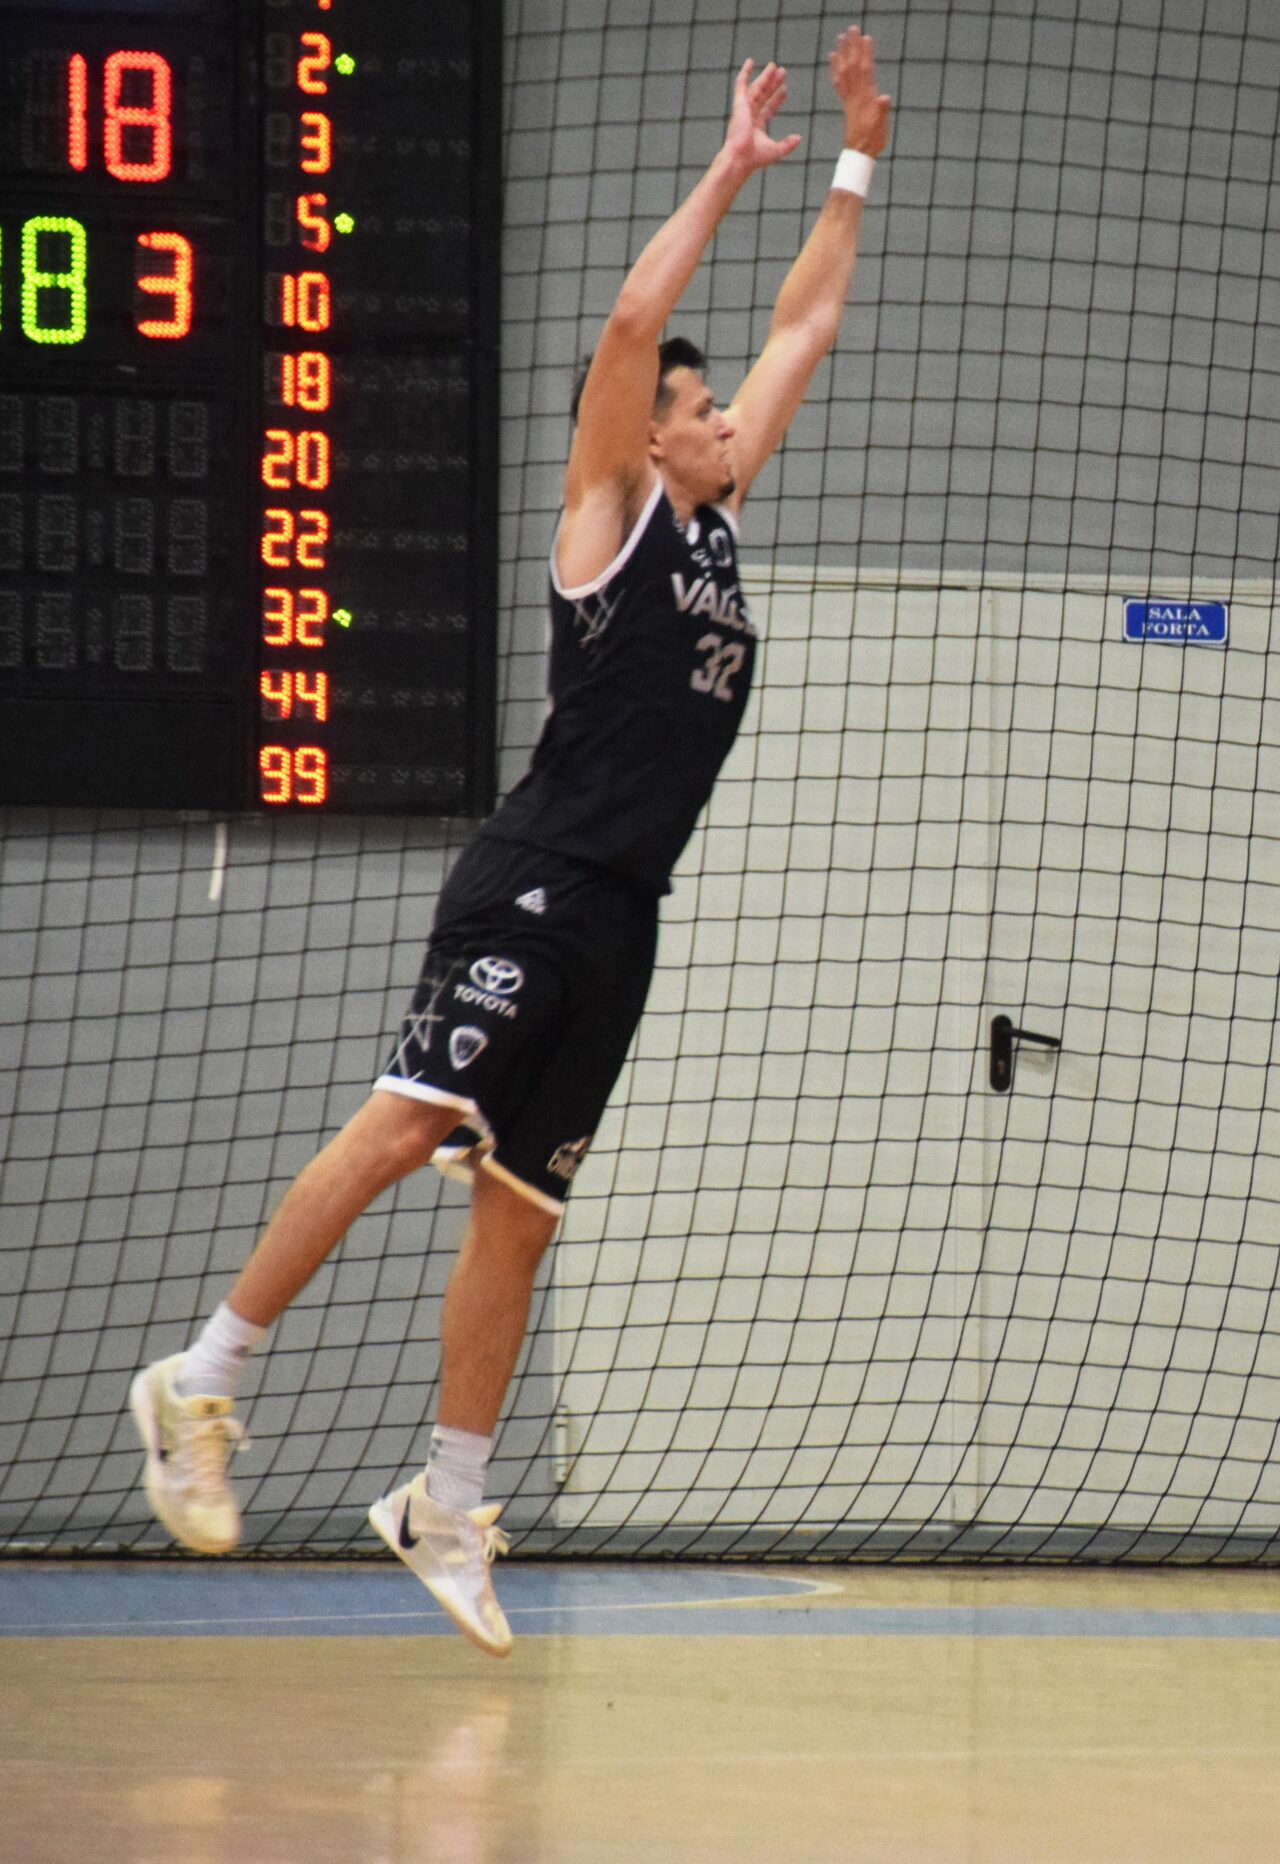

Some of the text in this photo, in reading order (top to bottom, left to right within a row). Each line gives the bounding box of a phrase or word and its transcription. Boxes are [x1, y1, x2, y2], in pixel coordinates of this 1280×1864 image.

[298, 33, 331, 94] 2
[68, 50, 171, 182] 18
[301, 112, 331, 173] 3
[298, 193, 330, 253] 5
[137, 232, 192, 339] 3
[283, 272, 329, 332] 10
[283, 352, 330, 411] 19
[262, 430, 330, 489] 20
[262, 508, 329, 568] 22
[262, 588, 328, 647] 32
[1148, 607, 1202, 621] SALA
[261, 670, 328, 722] 44
[260, 746, 328, 803] 99
[453, 983, 518, 1020] TOYOTA
